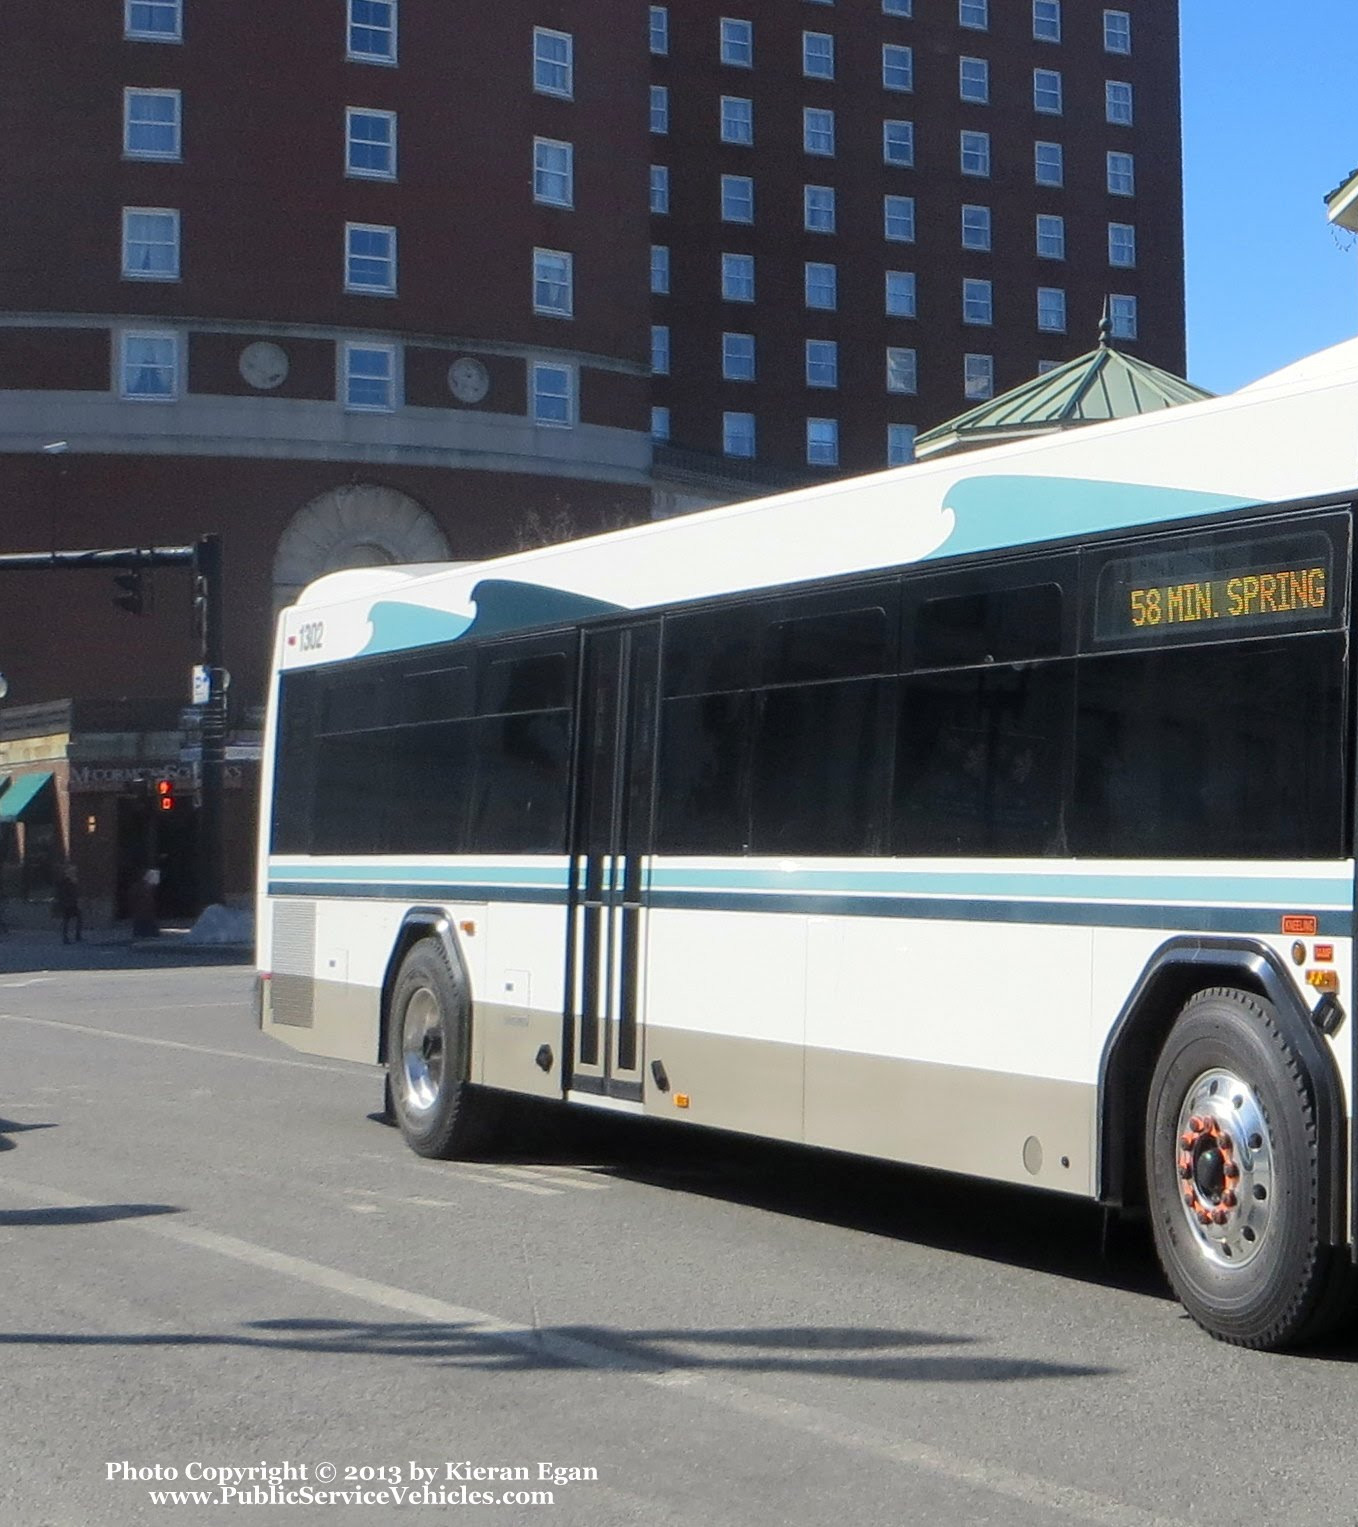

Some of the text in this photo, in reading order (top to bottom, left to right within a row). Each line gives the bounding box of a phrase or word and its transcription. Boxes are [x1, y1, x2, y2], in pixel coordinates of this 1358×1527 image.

[1130, 568, 1326, 627] 58 MIN. SPRING
[300, 621, 324, 652] 1302
